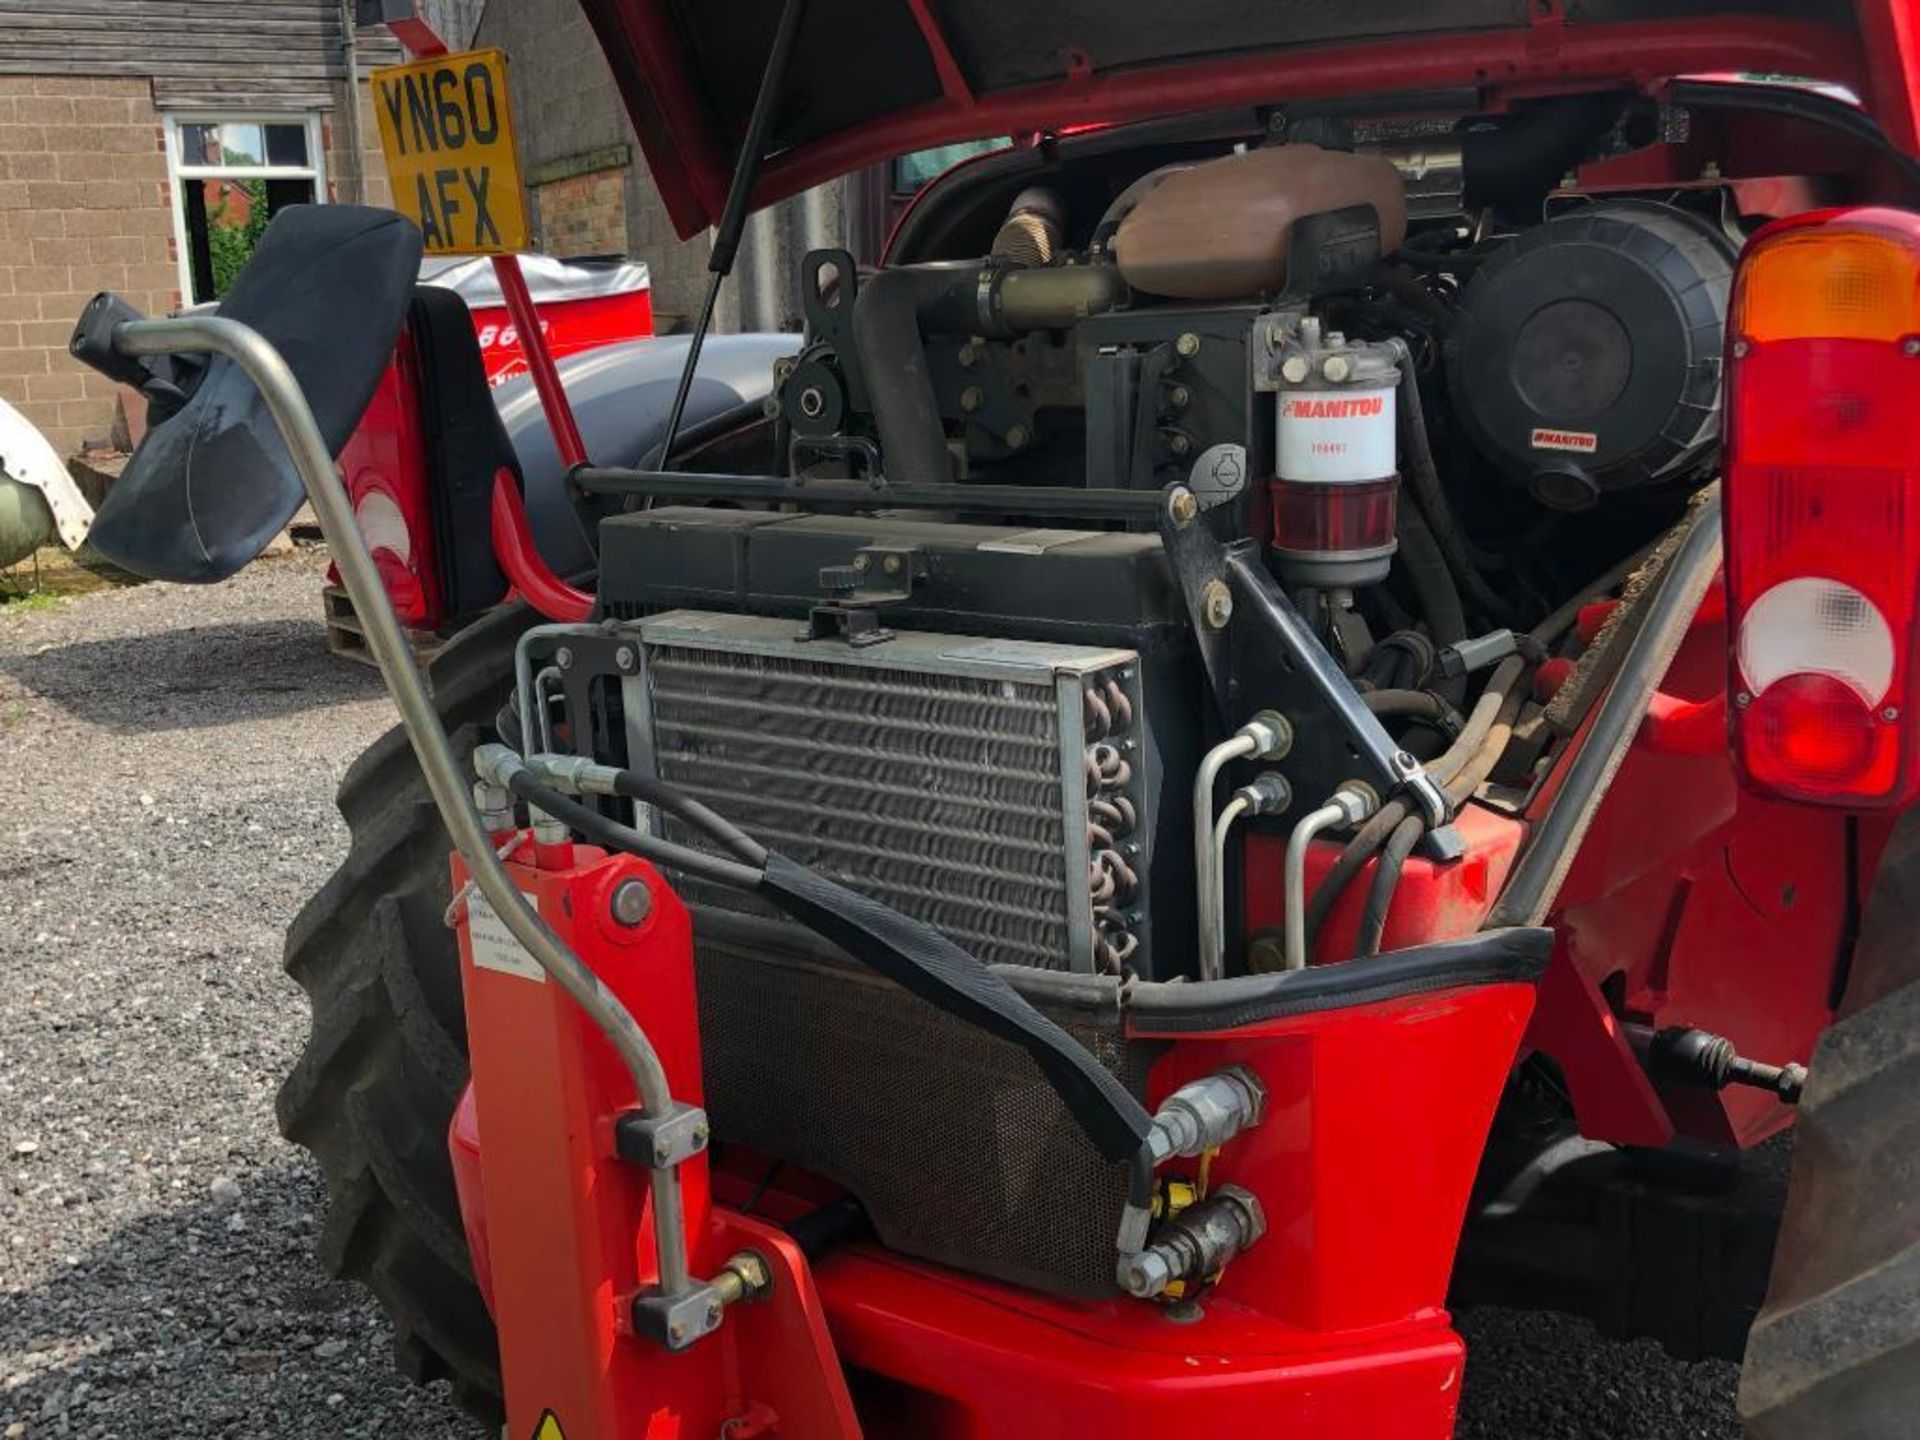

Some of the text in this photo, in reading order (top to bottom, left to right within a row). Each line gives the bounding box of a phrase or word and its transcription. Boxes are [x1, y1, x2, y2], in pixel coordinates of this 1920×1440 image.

[380, 62, 499, 155] YN60
[417, 166, 500, 249] AFX
[1293, 397, 1382, 418] MANITOU
